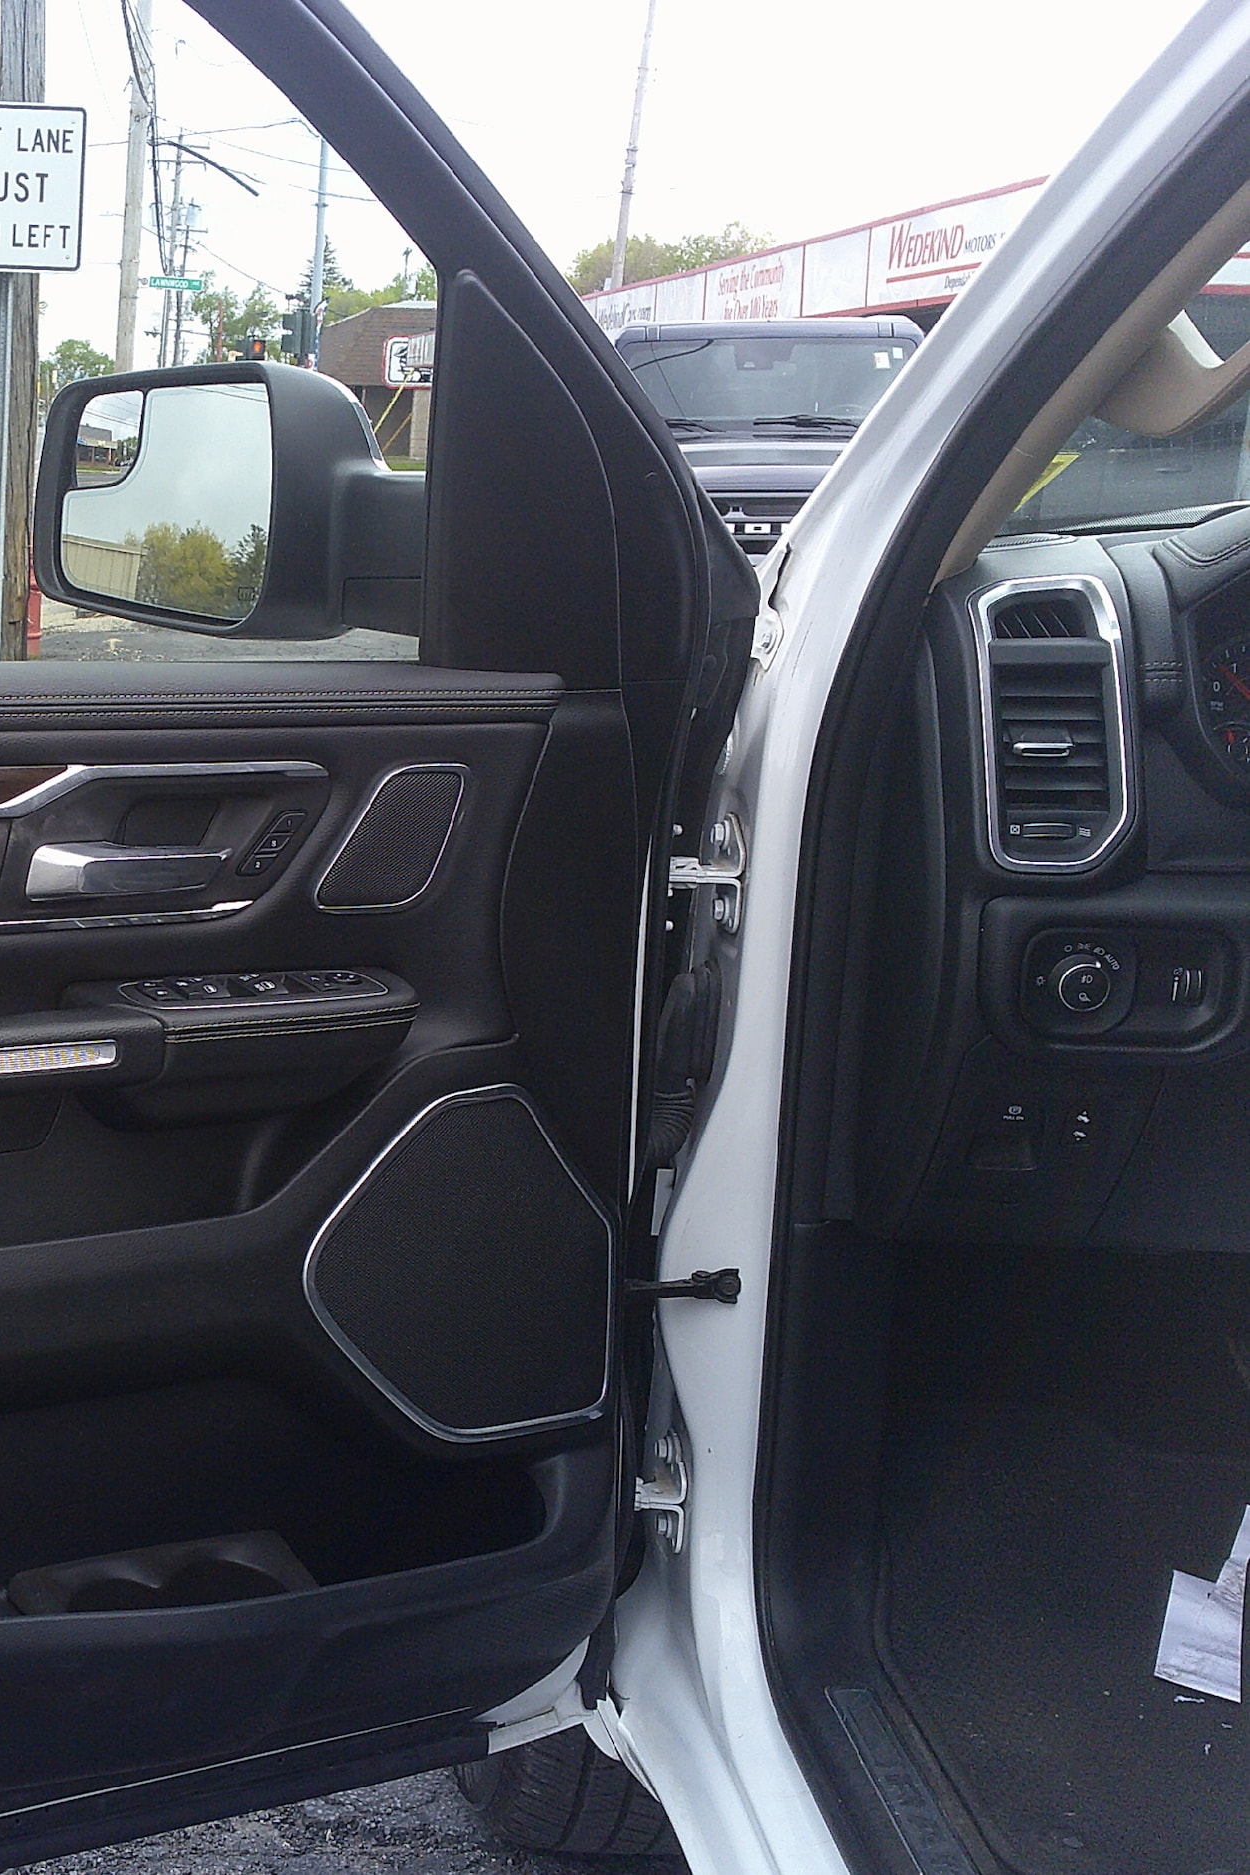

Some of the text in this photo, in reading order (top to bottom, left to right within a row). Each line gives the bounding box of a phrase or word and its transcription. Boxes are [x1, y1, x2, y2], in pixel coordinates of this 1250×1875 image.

[17, 128, 74, 153] LANE
[12, 223, 70, 249] LEFT
[888, 222, 996, 270] WEDEKIND MOTORS
[150, 279, 189, 288] LAWNWOOD
[717, 256, 784, 301] Serving the Community
[734, 299, 749, 320] Over
[1212, 681, 1221, 692] 0
